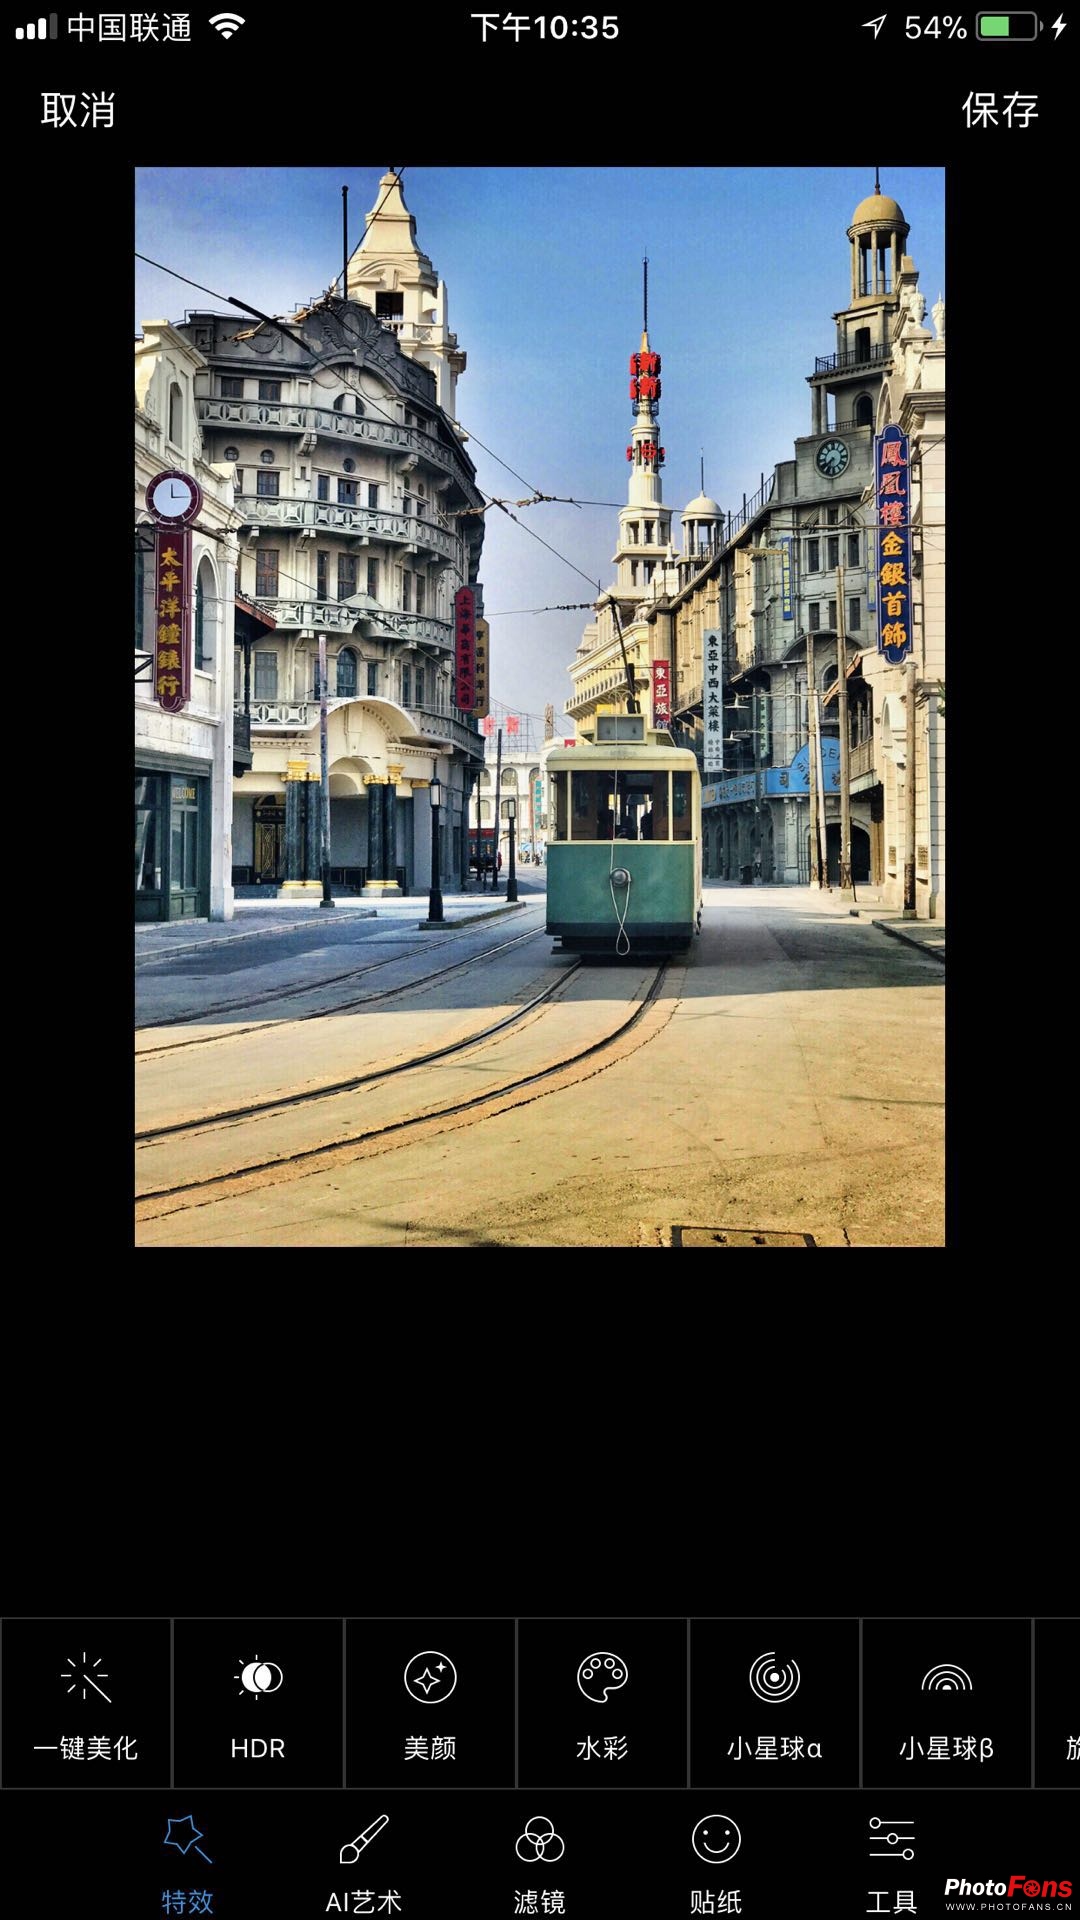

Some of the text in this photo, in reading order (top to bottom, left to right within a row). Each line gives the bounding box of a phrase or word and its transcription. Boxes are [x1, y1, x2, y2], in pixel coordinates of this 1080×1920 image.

[67, 12, 192, 43] 中国联通
[471, 12, 619, 43] 下午10:35
[905, 15, 968, 40] 54%
[40, 90, 116, 129] 取消
[961, 90, 1039, 129] 保存
[880, 440, 908, 649] 鳳凰樓金銀首飾
[157, 547, 183, 697] 太平洋鐘錶行
[707, 634, 720, 732] 東亞中西大菜樓
[33, 1735, 138, 1761] 一键美化
[231, 1738, 285, 1758] HDR
[404, 1735, 456, 1761] 美颜
[576, 1735, 629, 1761] 水彩
[727, 1735, 823, 1761] 小星球α
[899, 1735, 994, 1763] 小星球β
[161, 1889, 214, 1915] 特效
[325, 1889, 402, 1915] AI艺术
[514, 1889, 566, 1915] 滤镜
[690, 1889, 743, 1915] 贴纸
[865, 1890, 918, 1915] 工具
